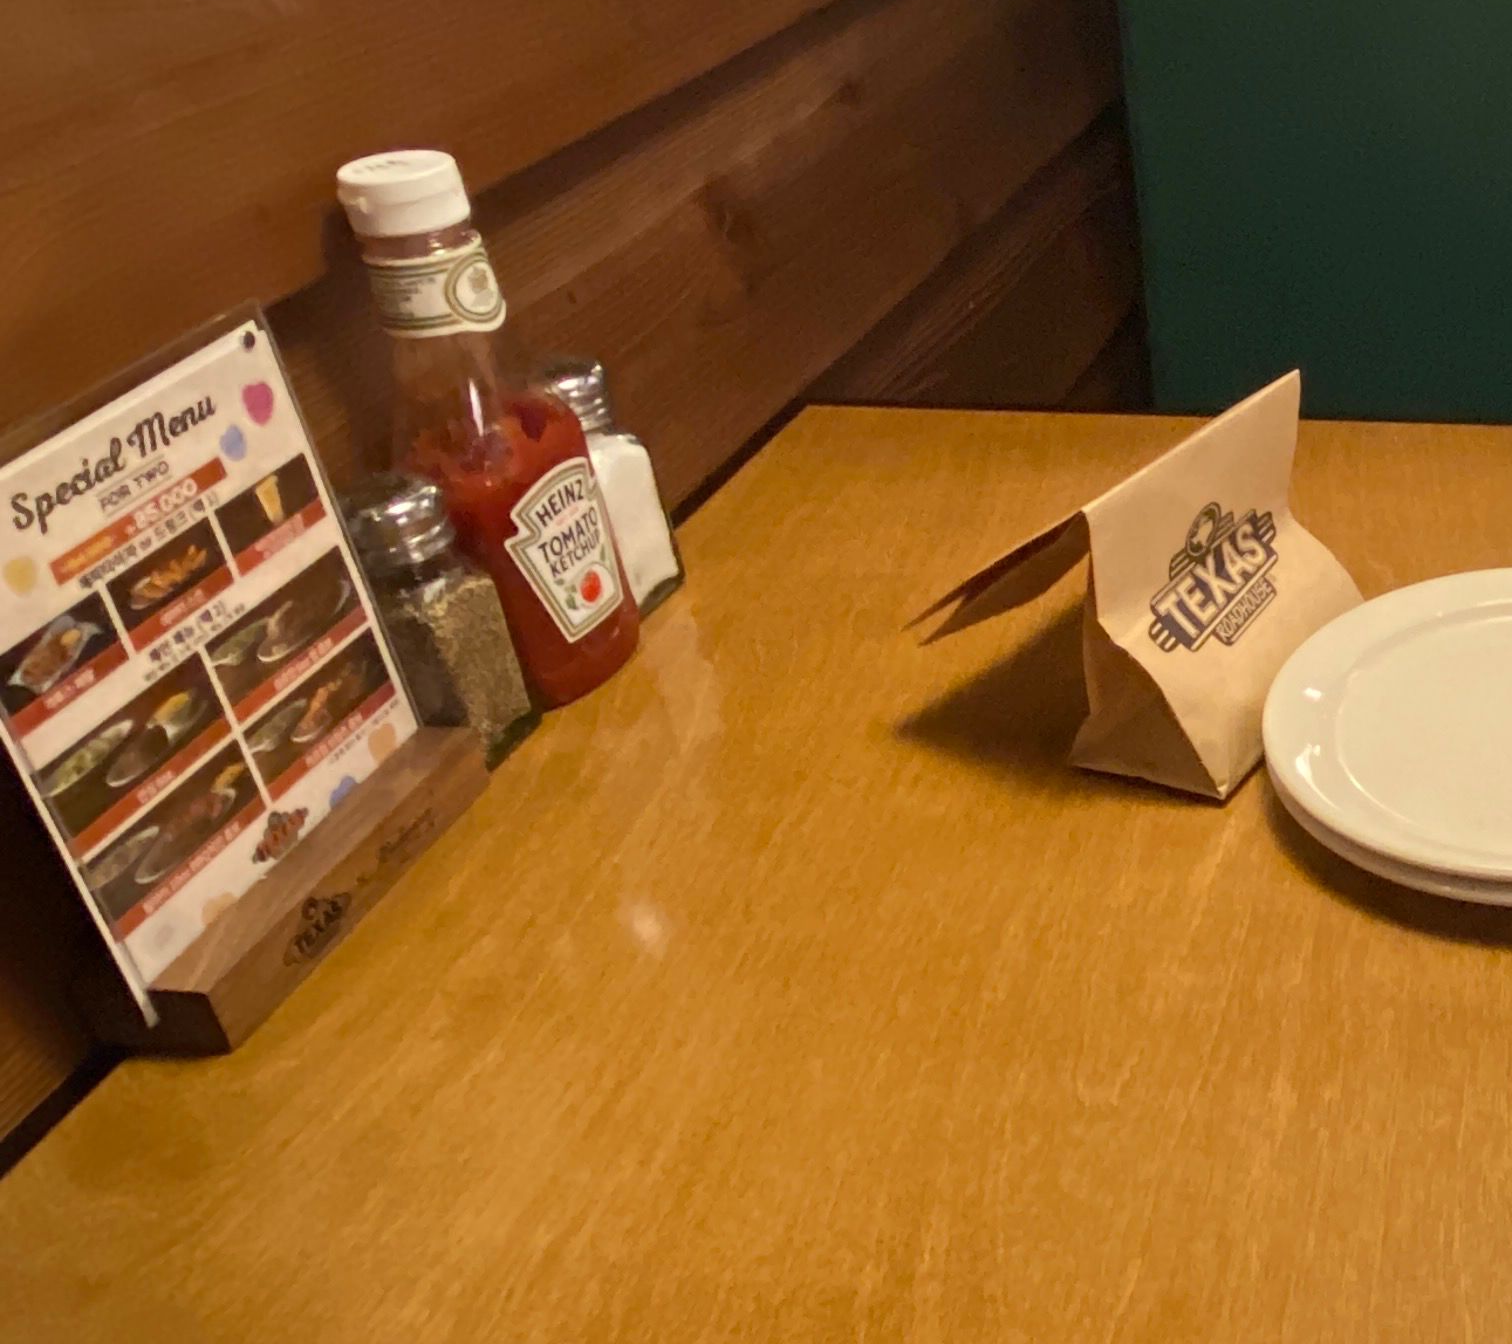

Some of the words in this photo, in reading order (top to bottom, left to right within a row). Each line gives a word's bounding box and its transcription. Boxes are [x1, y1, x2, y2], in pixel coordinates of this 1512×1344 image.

[10, 437, 125, 536] Special
[126, 395, 218, 458] Menu
[100, 485, 130, 512] FOR
[133, 460, 169, 488] TWO
[536, 479, 584, 527] HEINZ
[538, 506, 598, 563] TOMATO
[550, 528, 600, 577] KETCHUP
[1156, 522, 1268, 639] TEXAS
[1215, 578, 1274, 641] ROADHOUSE
